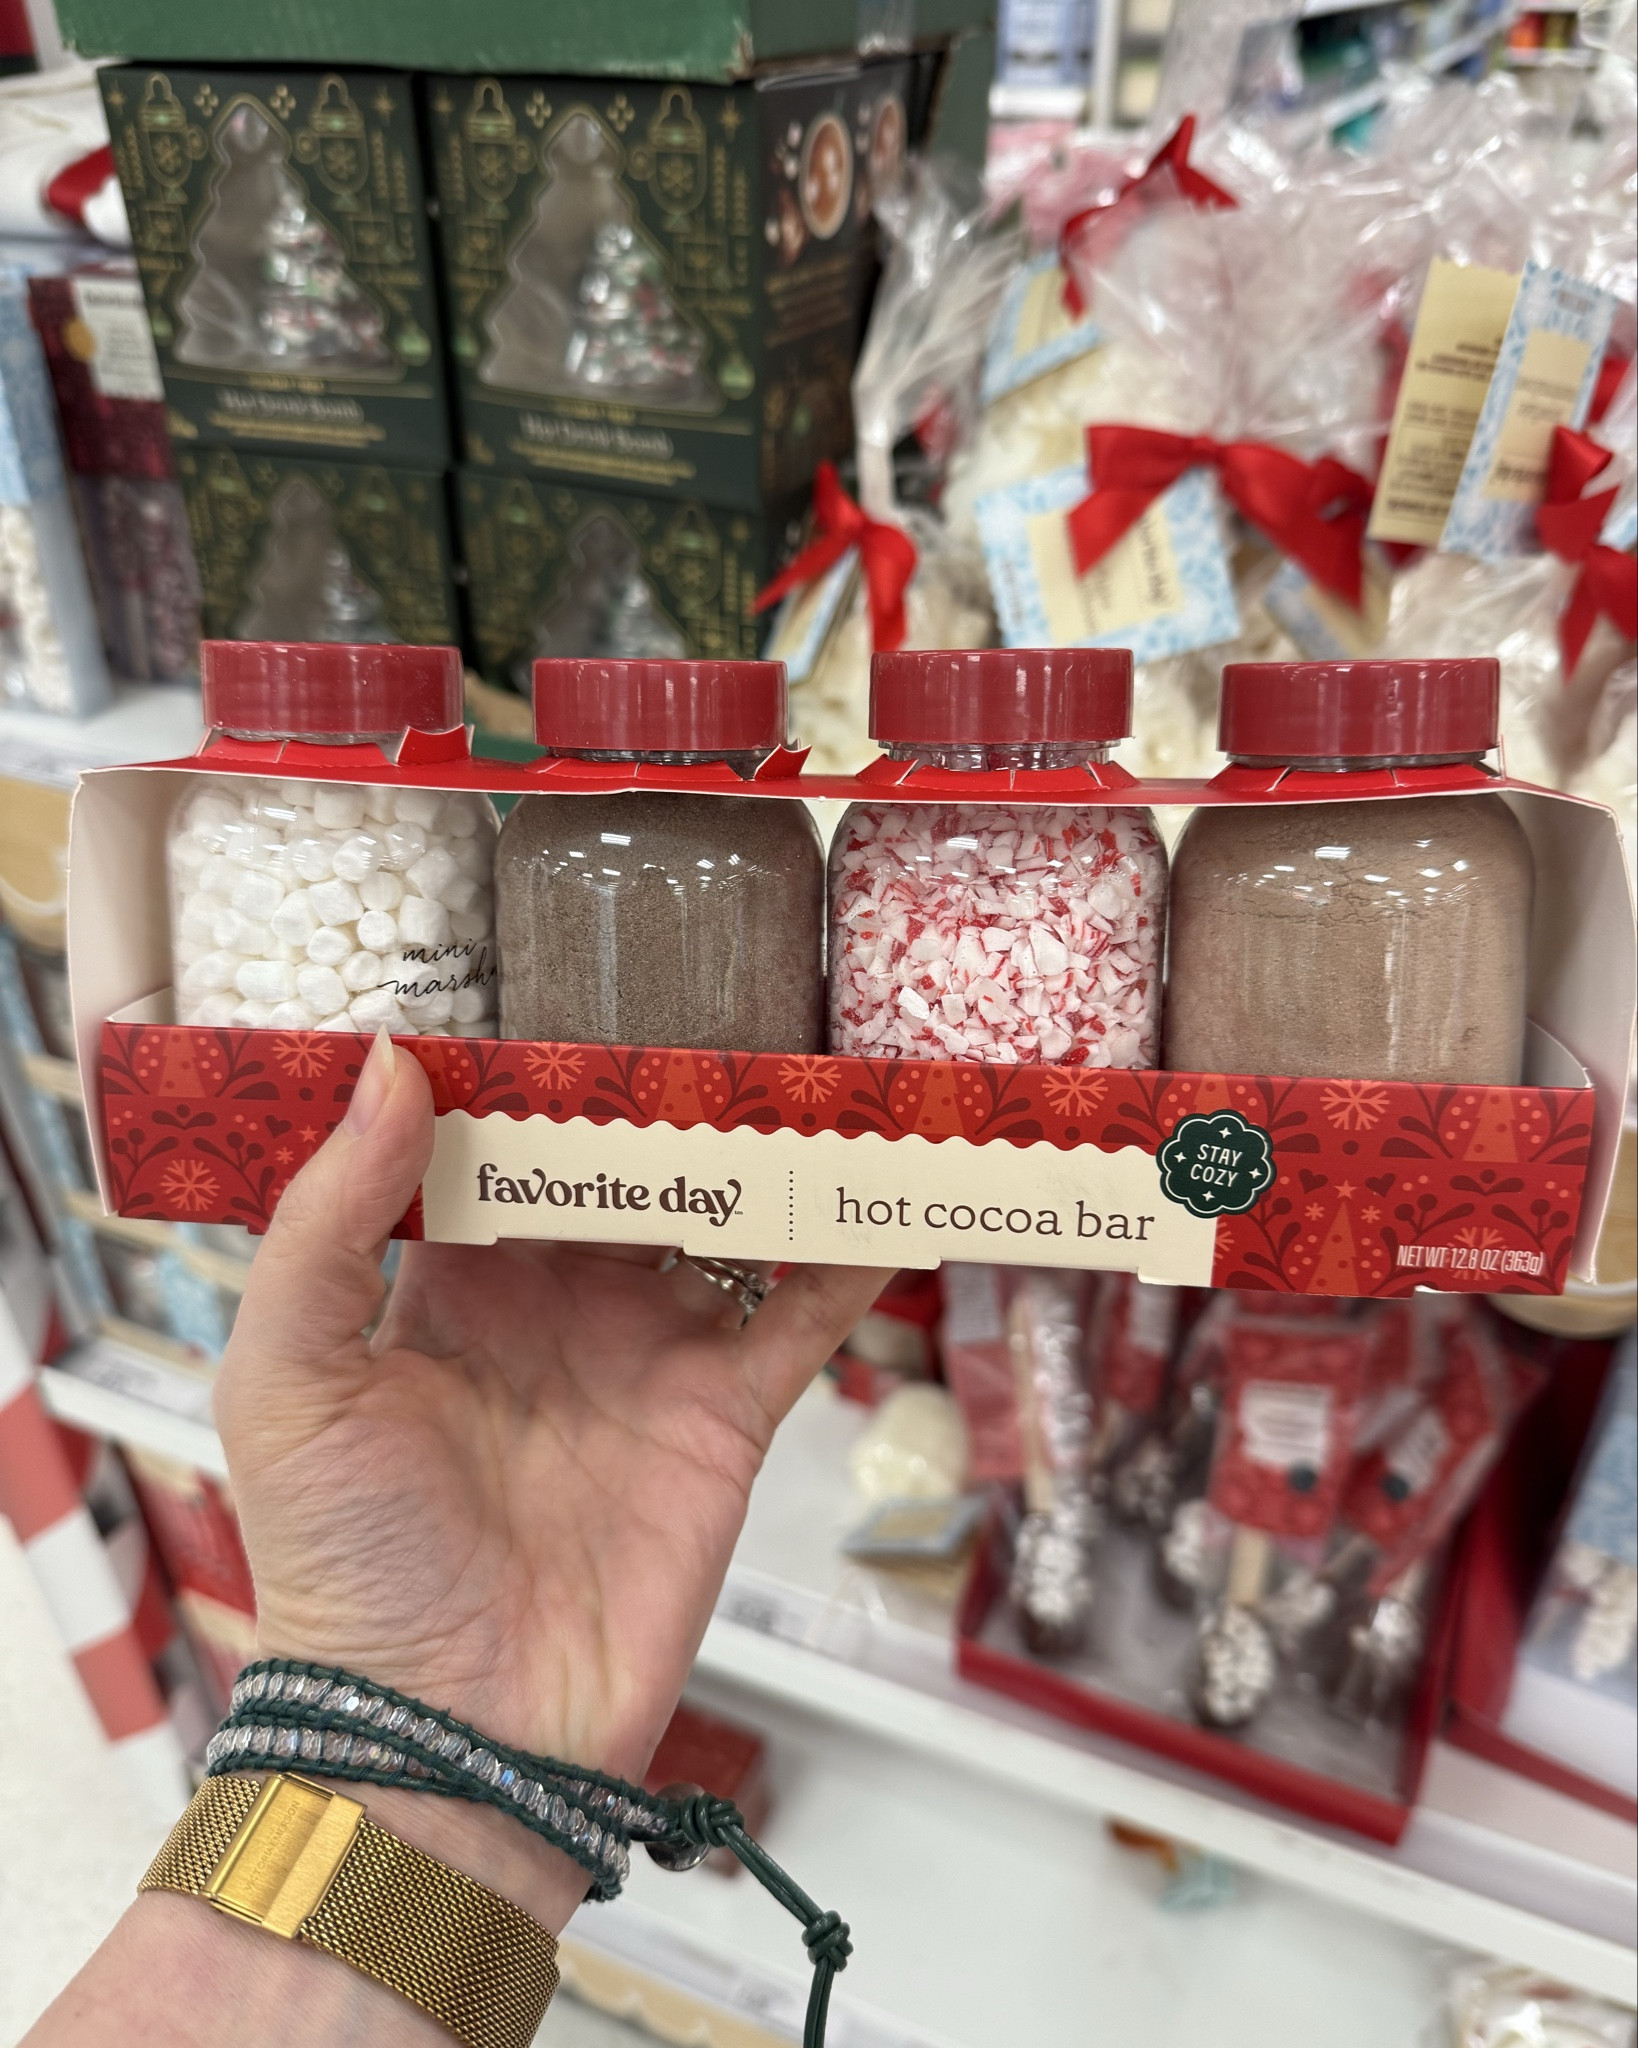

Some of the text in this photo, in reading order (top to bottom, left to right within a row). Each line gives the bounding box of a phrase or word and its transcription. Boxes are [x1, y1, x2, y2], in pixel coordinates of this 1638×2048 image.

[402, 938, 478, 964] mini
[1197, 1143, 1243, 1167] STAY
[1190, 1163, 1239, 1187] COZY
[476, 1163, 742, 1227] favorite day
[836, 1186, 1155, 1240] hot cocoa bar
[1396, 1244, 1545, 1276] NET WT 12.8 OZ (363g)
